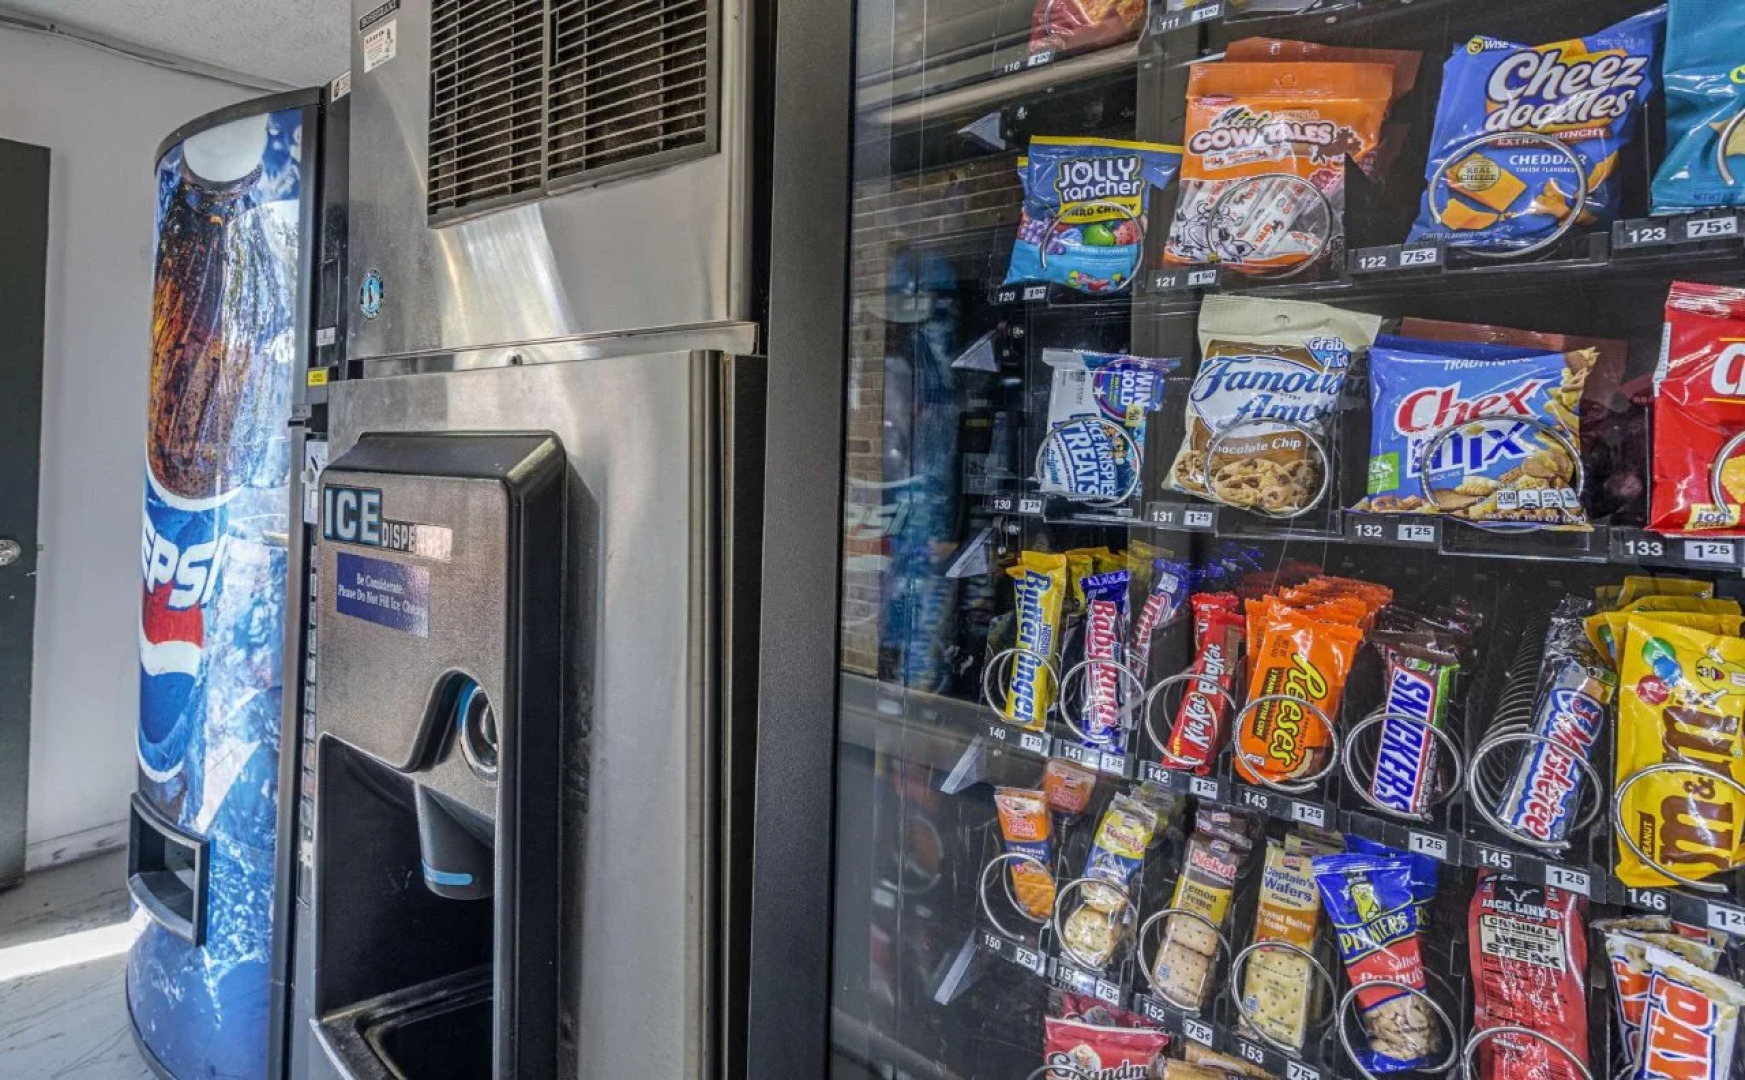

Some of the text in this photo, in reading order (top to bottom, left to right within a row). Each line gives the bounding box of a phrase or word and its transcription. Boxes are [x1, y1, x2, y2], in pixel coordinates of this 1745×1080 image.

[1161, 18, 1179, 30] 111
[1004, 62, 1020, 73] 110
[1488, 51, 1648, 101] Cheez
[1485, 86, 1636, 131] doodles
[1190, 122, 1333, 153] COW TALES
[1550, 127, 1606, 140] RUNCHY
[1509, 154, 1587, 165] CHEDDAR
[1058, 158, 1136, 188] JOLLY
[1063, 180, 1140, 201] rancher
[1063, 206, 1094, 217] ARD
[1629, 228, 1667, 243] 123
[1690, 220, 1734, 236] 75¢
[1359, 256, 1386, 268] 122
[1404, 249, 1434, 263] 75¢
[1156, 276, 1175, 287] 121
[999, 292, 1014, 302] 120
[1309, 337, 1344, 350] Grab
[1443, 357, 1533, 371] TRADITION
[1121, 370, 1136, 406] GOLD
[1190, 356, 1346, 402] Famous
[1134, 371, 1154, 407] WIN
[1398, 382, 1539, 432] Chex
[1271, 437, 1301, 450] Chip
[1411, 422, 1527, 474] mix
[1063, 421, 1100, 497] TREATS
[1095, 442, 1118, 497] KRISPIES
[994, 499, 1011, 510] 130
[1497, 491, 1515, 500] 200
[325, 488, 380, 543] ICE
[1152, 511, 1173, 522] 131
[1546, 514, 1560, 523] OZ
[1355, 523, 1382, 537] 132
[1625, 541, 1664, 556] 133
[357, 573, 364, 585] Be
[338, 585, 356, 599] Please
[357, 589, 365, 602] Do
[367, 591, 378, 604] Not
[379, 594, 390, 608] Fill
[391, 597, 400, 611] Ice
[1091, 599, 1118, 727] Baby Ruth
[1270, 653, 1326, 765] Reese's
[1571, 697, 1600, 728] 3
[989, 727, 1006, 740] 140
[1374, 671, 1431, 812] SNICKERS
[1065, 746, 1082, 759] 141
[1148, 767, 1169, 783] 142
[1244, 792, 1268, 808] 143
[1640, 820, 1653, 856] PEANUT
[1191, 850, 1237, 880] Nekot
[1479, 850, 1512, 868] 145
[1265, 865, 1314, 890] Captain's
[1185, 882, 1217, 902] Lemon
[1265, 876, 1312, 902] Wafers
[1482, 898, 1513, 911] JACK
[1515, 902, 1560, 920] LINK'S
[1627, 888, 1667, 911] 146
[1263, 917, 1289, 935] Honey
[1286, 914, 1312, 932] Butter
[1489, 917, 1553, 937] ORIGINAL
[985, 934, 1001, 950] 150
[1339, 913, 1409, 954] PLANTERS
[1495, 934, 1551, 953] BEEF
[1387, 950, 1420, 971] Salted
[1486, 942, 1560, 967] STEAK
[1361, 967, 1424, 984] Peanuts
[1143, 1003, 1165, 1022] 152
[1188, 1021, 1211, 1041] 75¢
[1240, 1043, 1264, 1064] 153
